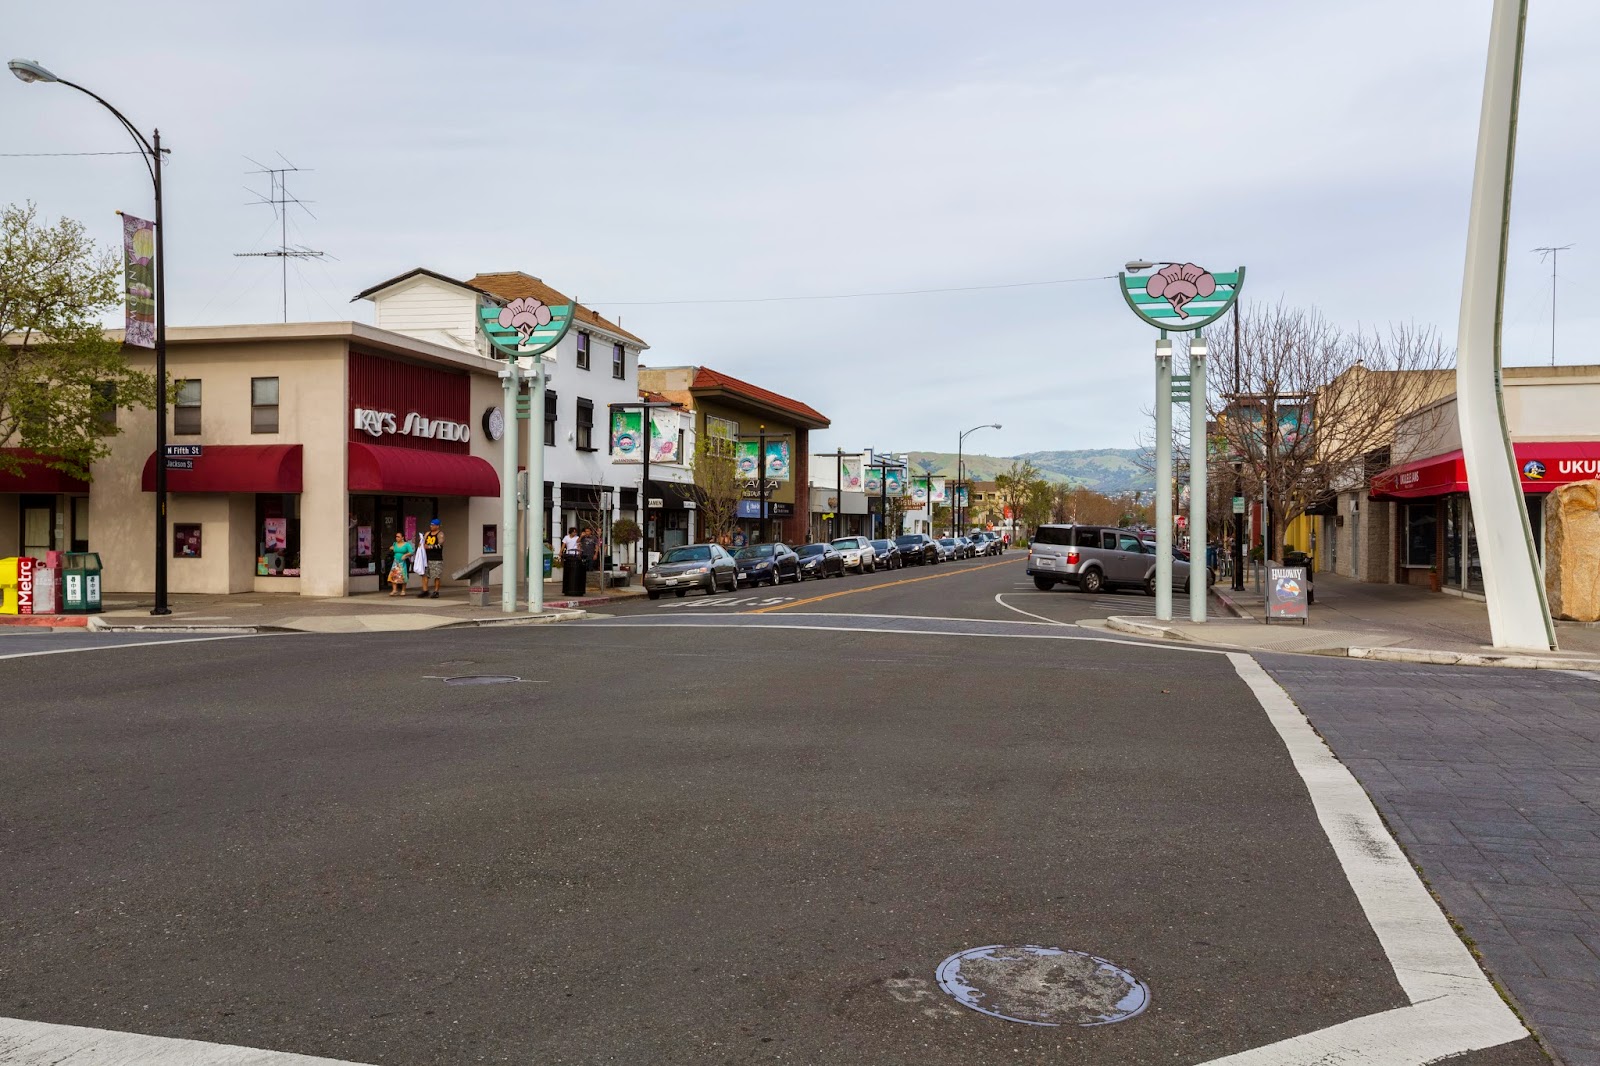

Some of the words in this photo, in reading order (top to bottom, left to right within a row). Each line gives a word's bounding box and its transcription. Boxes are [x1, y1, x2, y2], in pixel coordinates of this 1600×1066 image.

[354, 408, 397, 437] KAY'S
[167, 446, 172, 454] N
[173, 446, 190, 454] Fifth
[191, 446, 199, 454] St
[166, 459, 186, 468] Jackson
[186, 460, 193, 469] St
